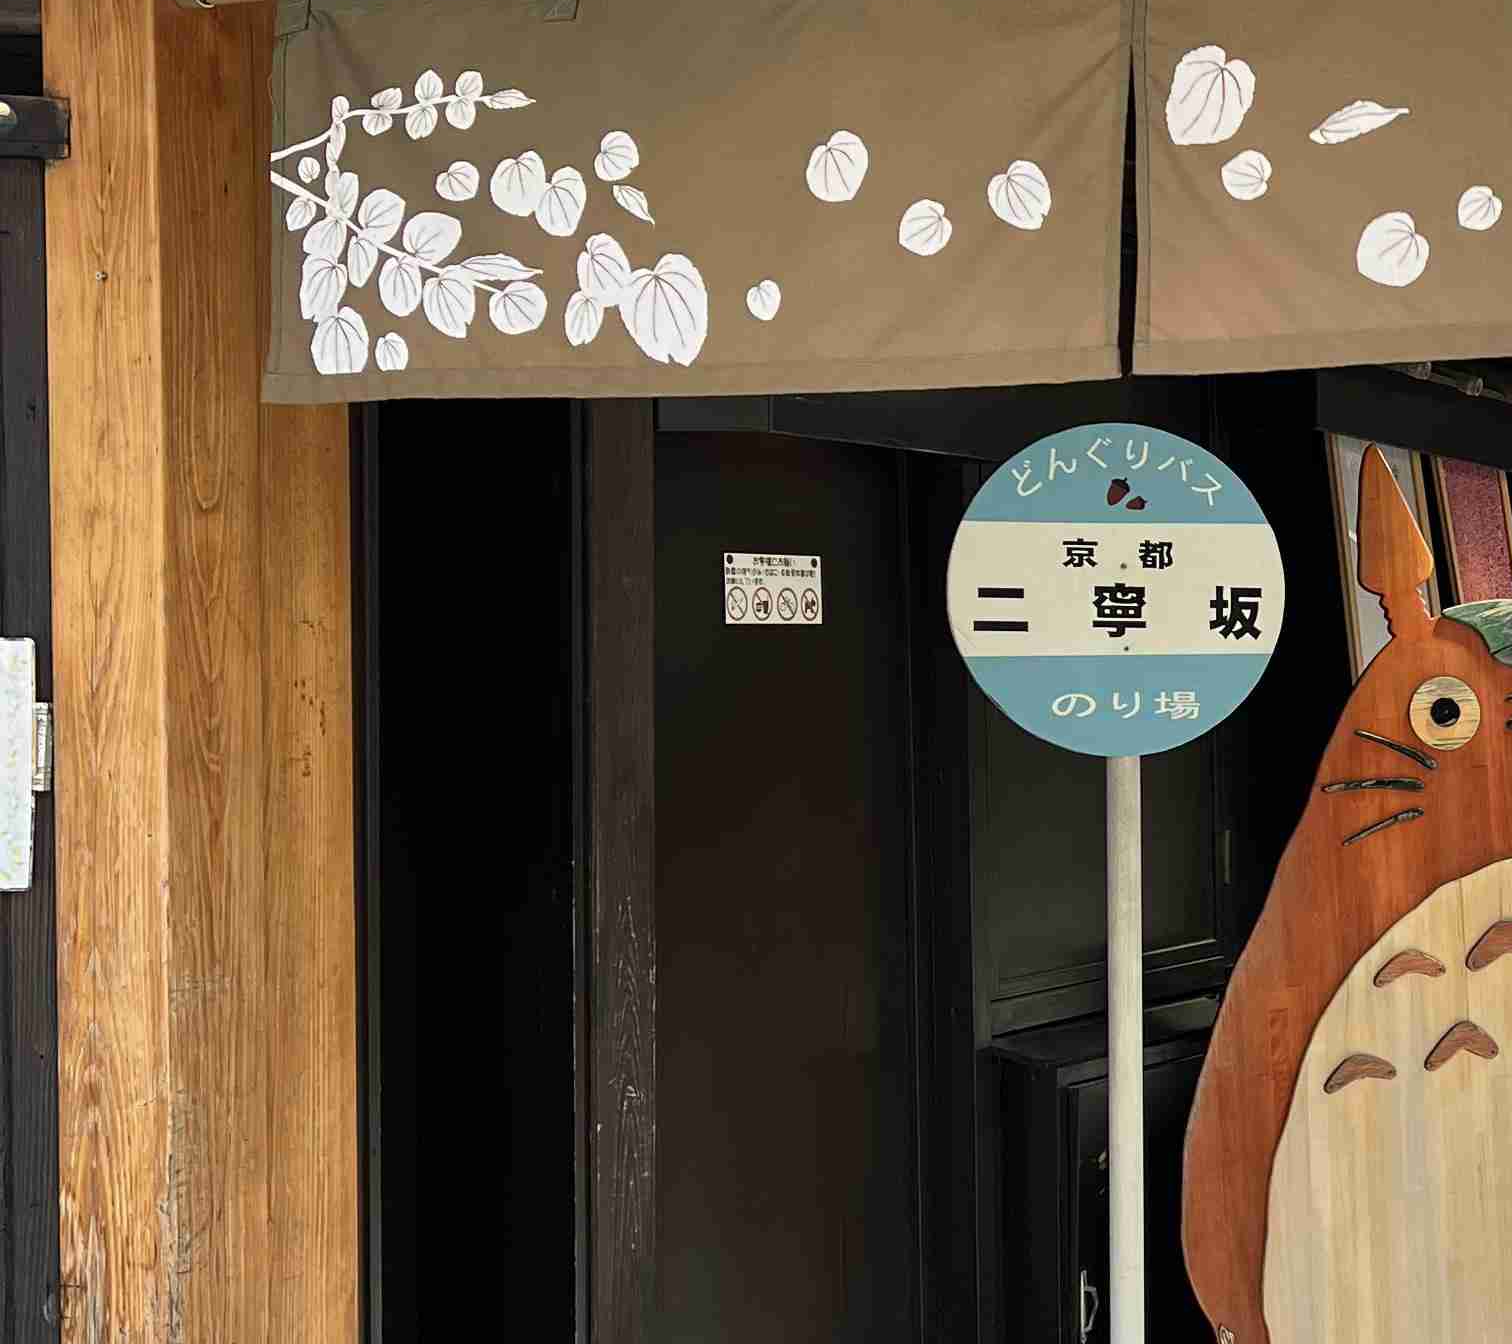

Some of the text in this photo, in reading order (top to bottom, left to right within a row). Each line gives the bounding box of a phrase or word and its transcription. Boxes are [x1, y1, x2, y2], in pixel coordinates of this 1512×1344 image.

[1011, 436, 1223, 507] どんぐりバス
[1062, 537, 1174, 570] 京都
[973, 582, 1263, 640] 二寧坂
[1051, 690, 1201, 720] のり場
